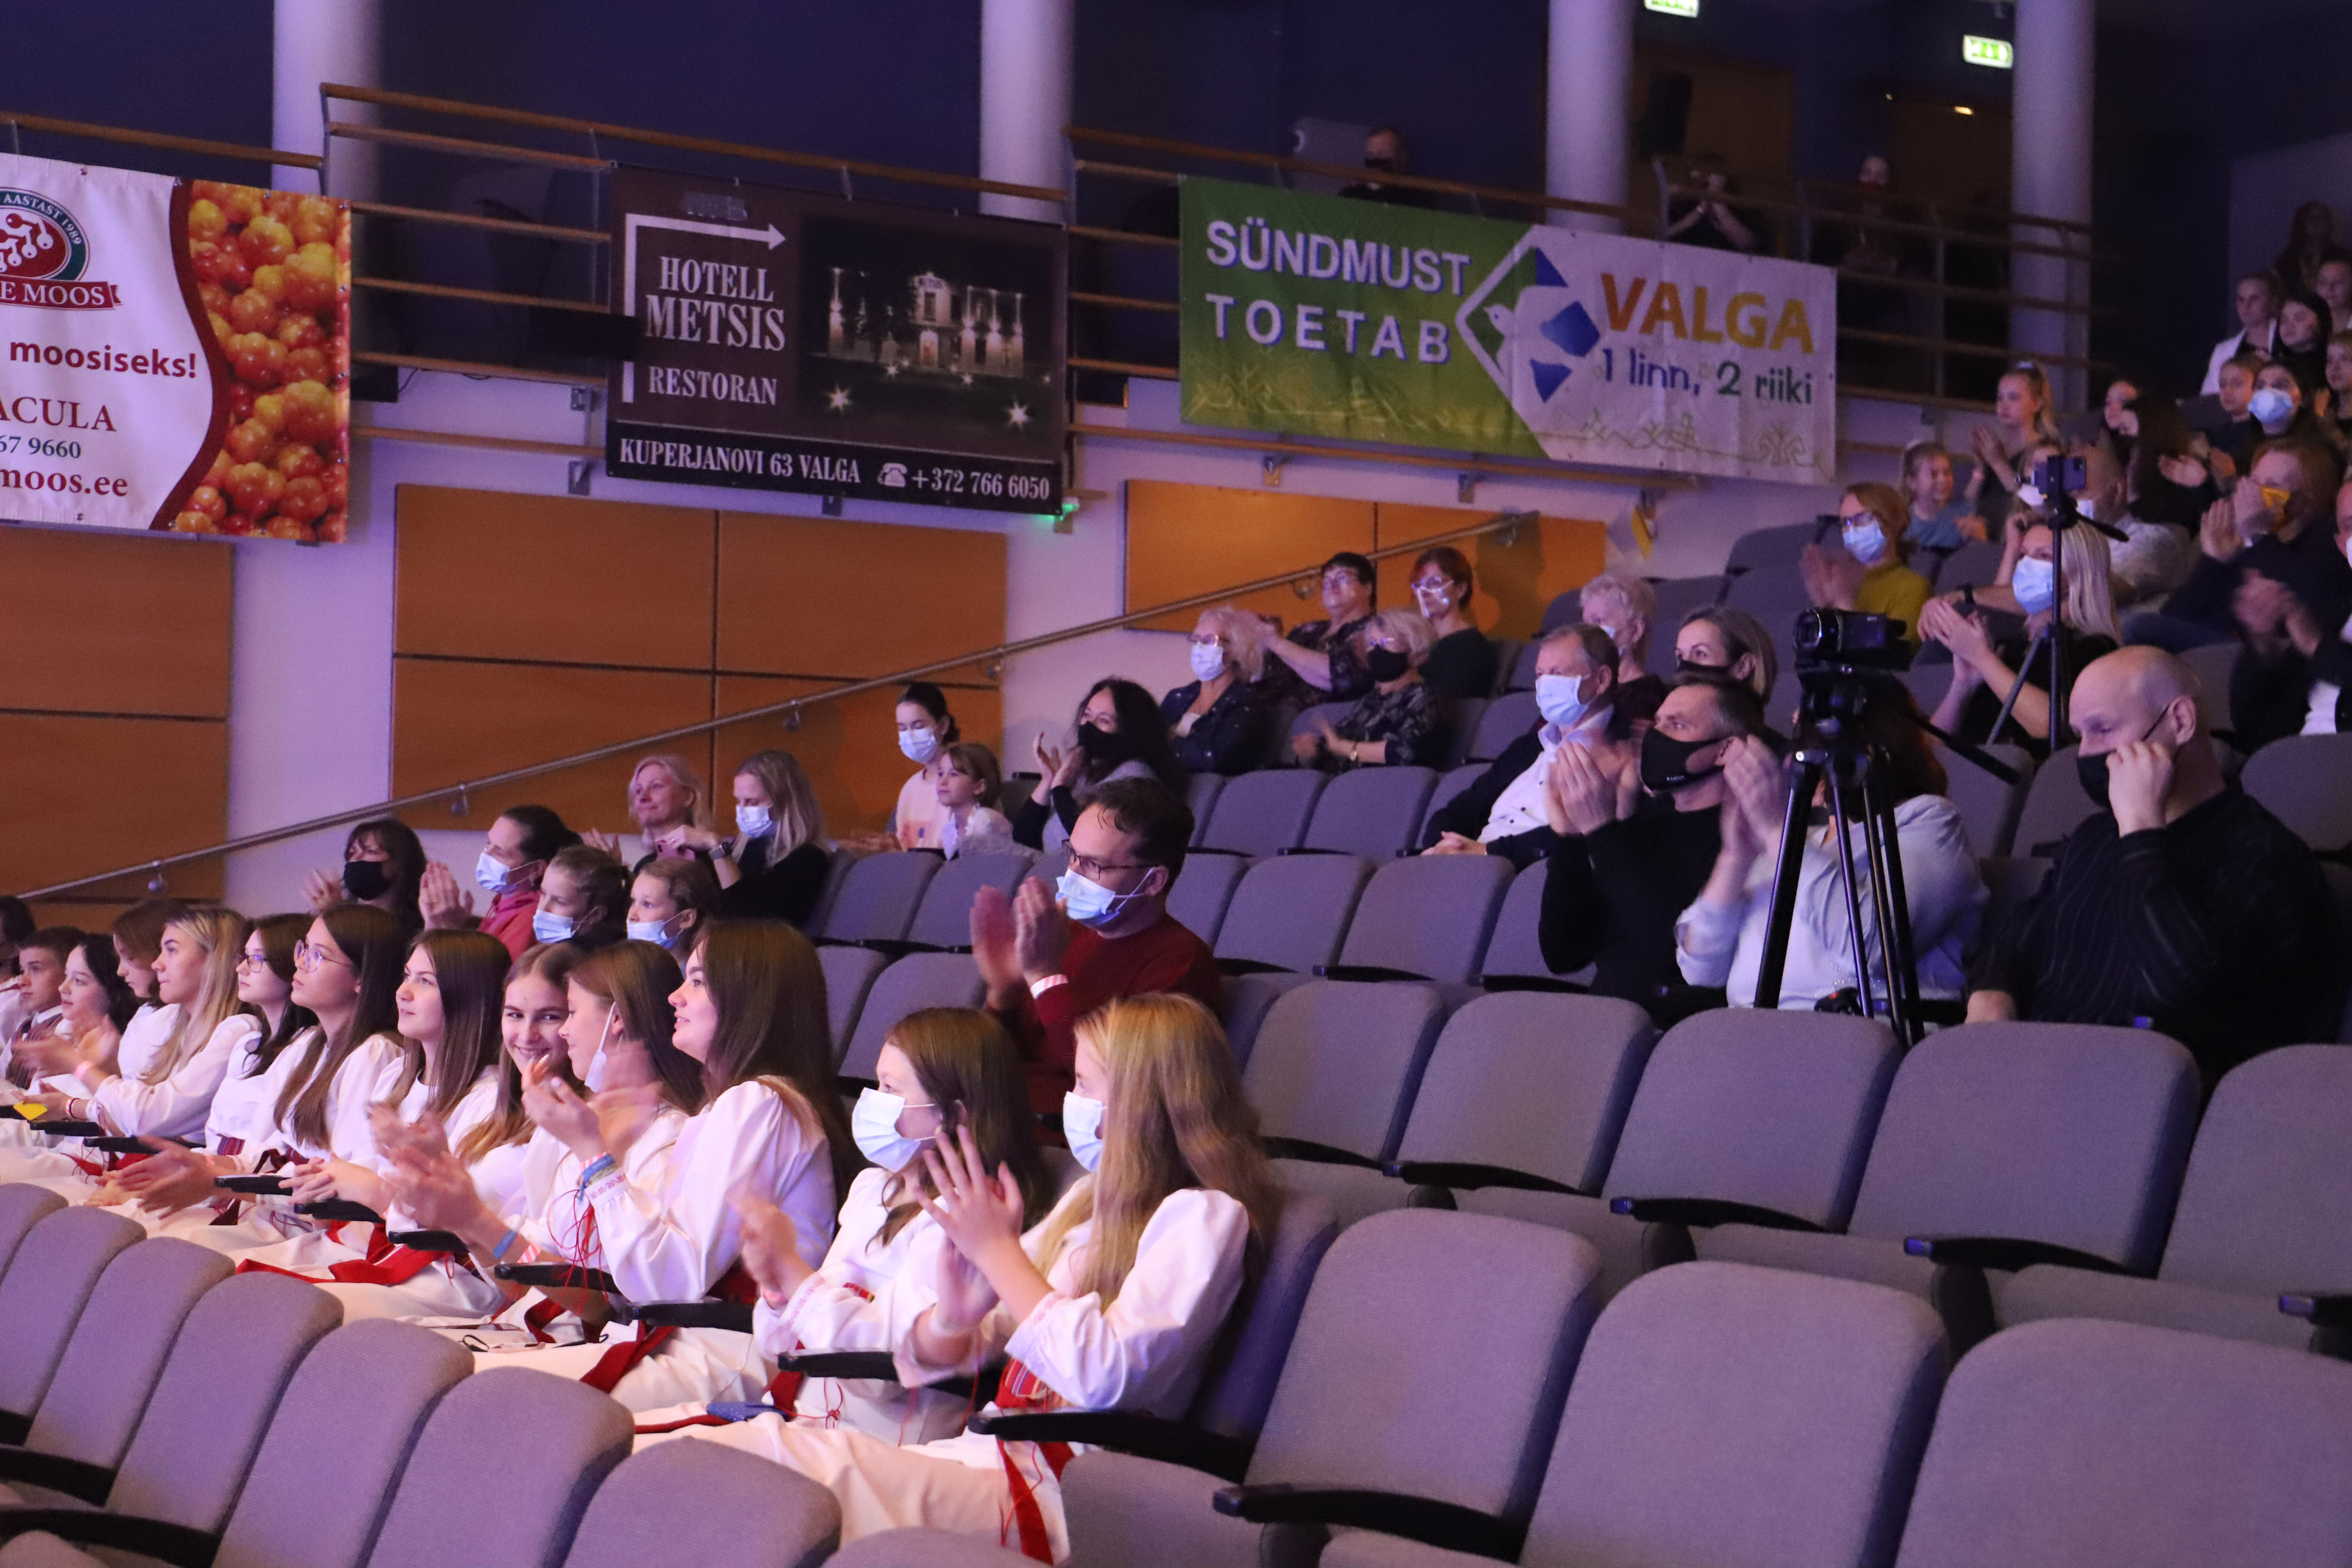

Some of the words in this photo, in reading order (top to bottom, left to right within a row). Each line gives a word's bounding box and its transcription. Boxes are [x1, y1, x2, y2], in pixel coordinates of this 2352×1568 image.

[3, 193, 63, 218] AASTAST
[62, 218, 82, 245] 1989
[660, 256, 774, 302] HOTELL
[1206, 216, 1472, 296] SÜNDMUST
[23, 283, 105, 305] MOOS
[1600, 273, 1815, 355] VALGA
[645, 294, 786, 351] METSIS
[1206, 293, 1450, 364] TOETAB
[10, 342, 196, 378] moosiseks!
[648, 366, 777, 406] RESTORAN
[1603, 348, 1613, 382] 1
[1629, 348, 1701, 396] linn,
[1717, 361, 1742, 396] 2
[1756, 366, 1811, 404] riiki
[28, 437, 81, 459] 9660
[620, 438, 764, 474] KUPERJANOVI
[770, 453, 793, 477] 63
[799, 454, 861, 483] VALGA
[911, 467, 964, 493] +372
[970, 471, 1003, 496] 766
[1008, 475, 1050, 500] 6050
[0, 469, 128, 496] moos.ee
